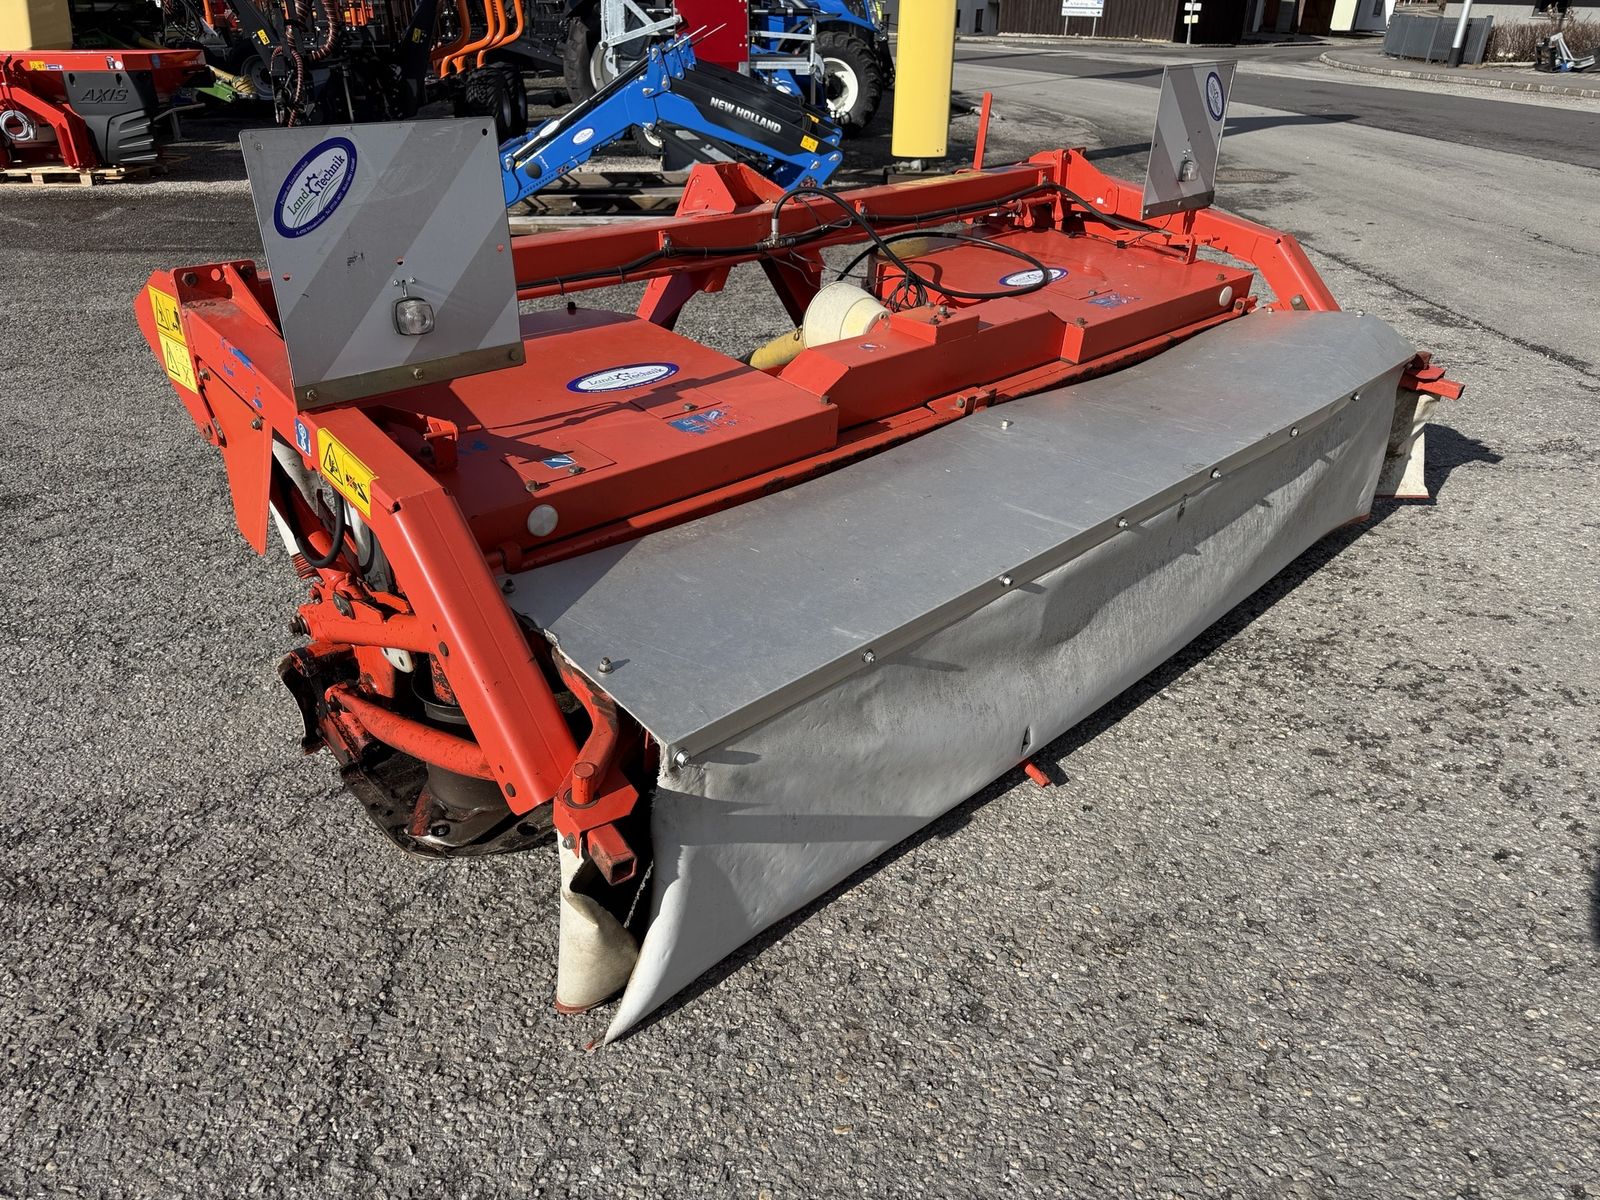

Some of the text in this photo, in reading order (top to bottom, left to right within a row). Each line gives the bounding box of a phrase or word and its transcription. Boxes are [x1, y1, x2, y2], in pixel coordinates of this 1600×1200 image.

[80, 88, 129, 103] AXIS
[710, 96, 782, 134] NEW HOLLAND
[287, 188, 310, 216] Land
[314, 155, 346, 191] Technik
